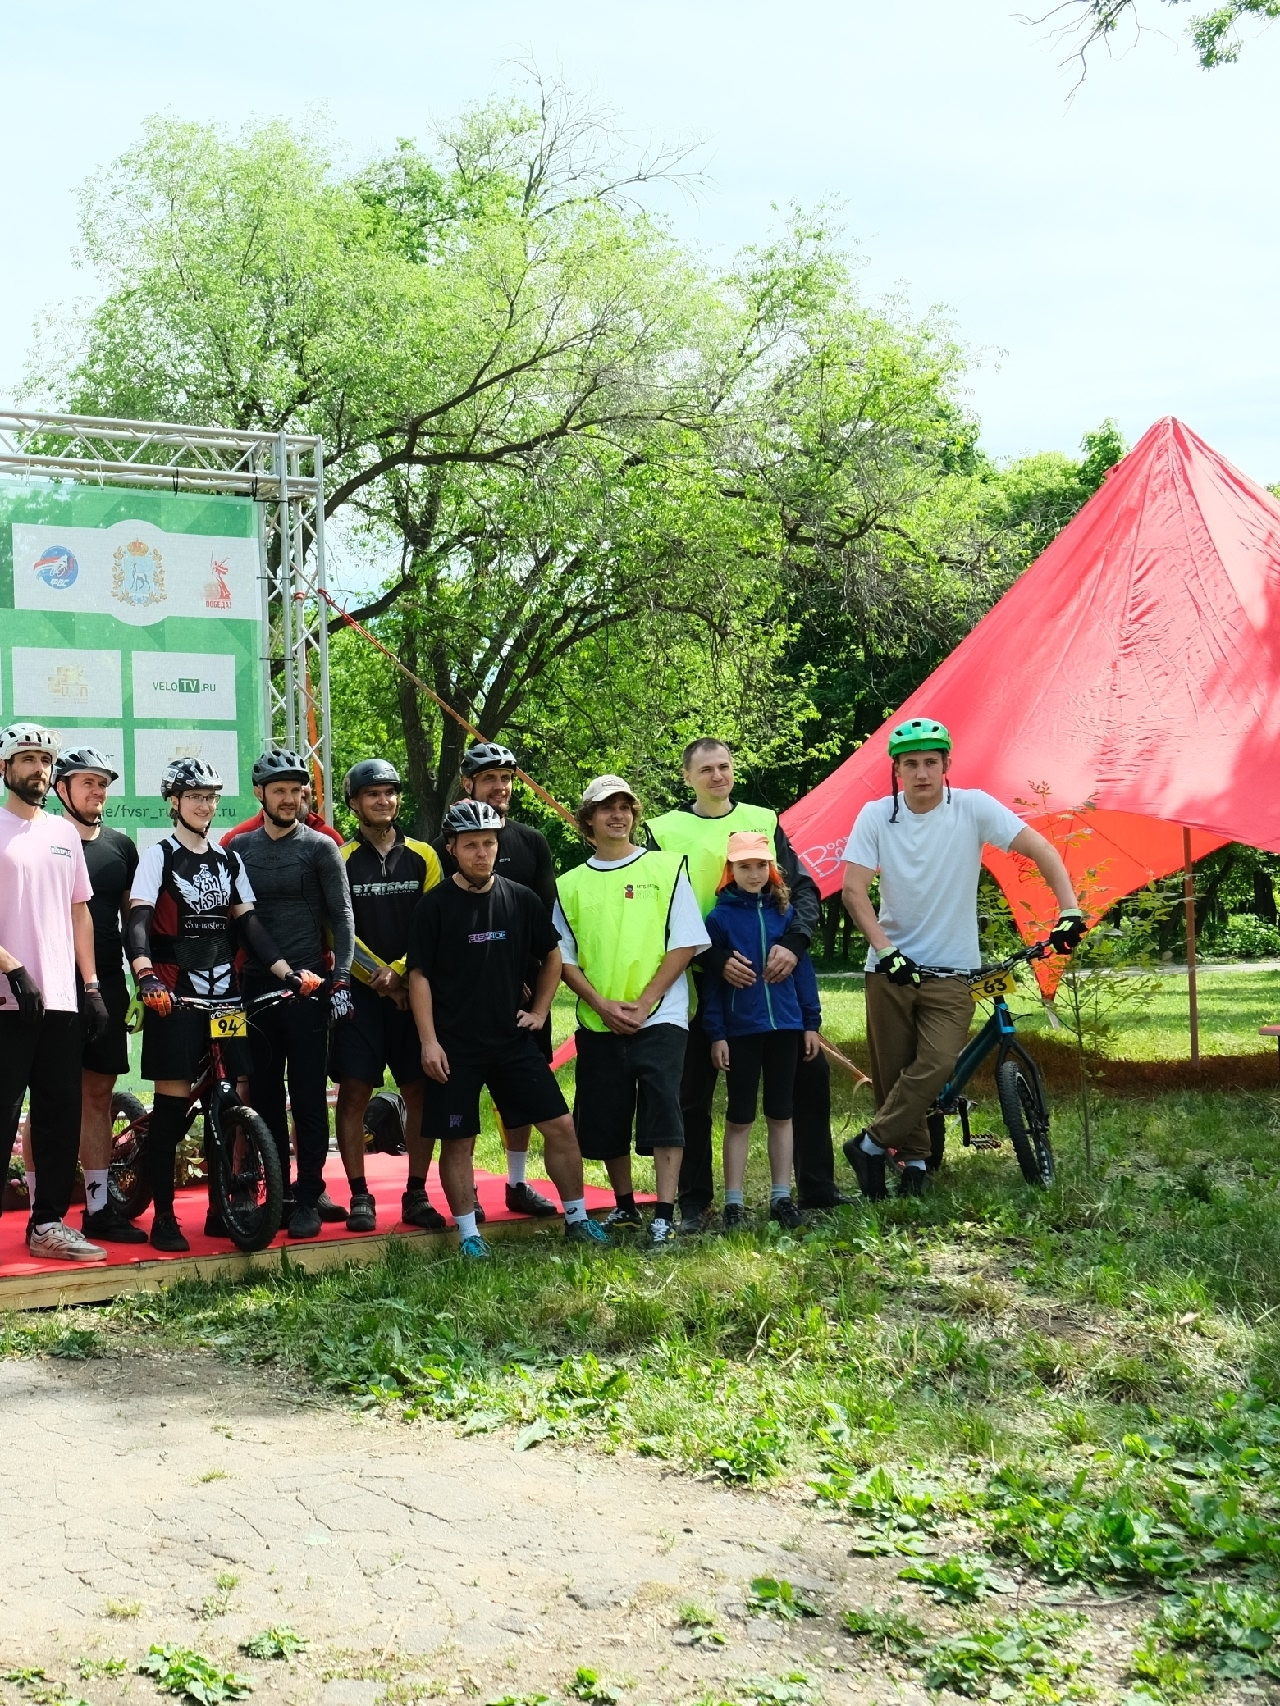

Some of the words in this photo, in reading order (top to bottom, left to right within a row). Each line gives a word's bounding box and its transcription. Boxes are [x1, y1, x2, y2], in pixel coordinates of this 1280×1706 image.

[205, 600, 232, 610] ПОБЕДА!
[984, 978, 1007, 993] 63
[218, 1019, 237, 1034] 94
